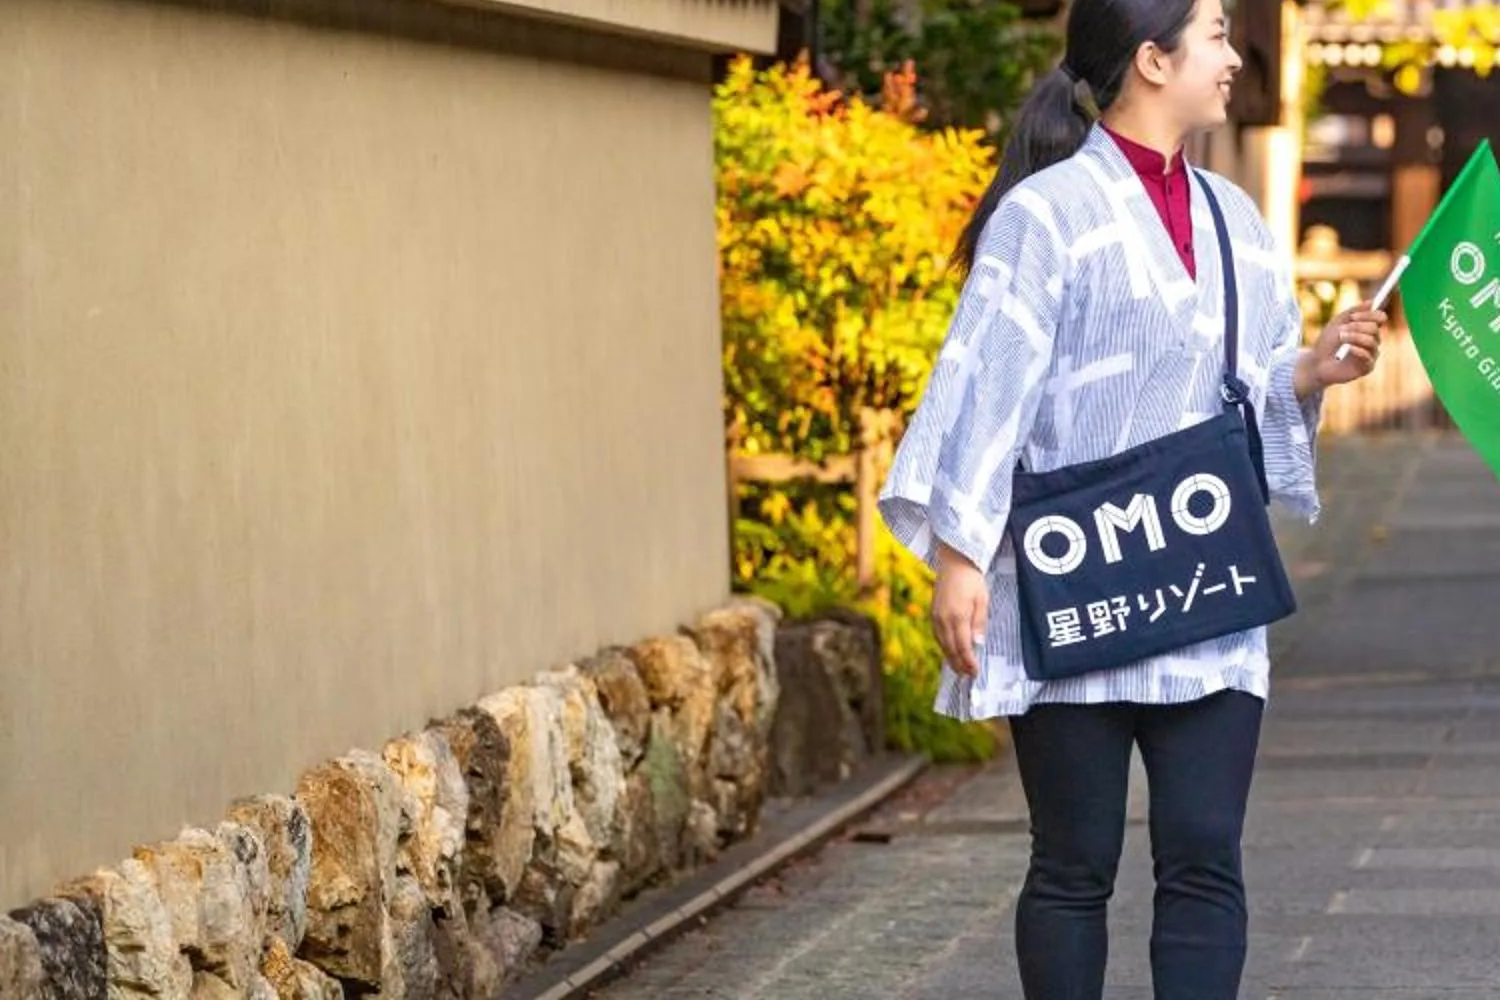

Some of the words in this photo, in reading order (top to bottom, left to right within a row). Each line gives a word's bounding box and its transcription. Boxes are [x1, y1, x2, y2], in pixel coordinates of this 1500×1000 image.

[1438, 298, 1480, 359] Kyoto
[1023, 473, 1232, 575] OMO
[1046, 562, 1257, 648] 星野リゾート
